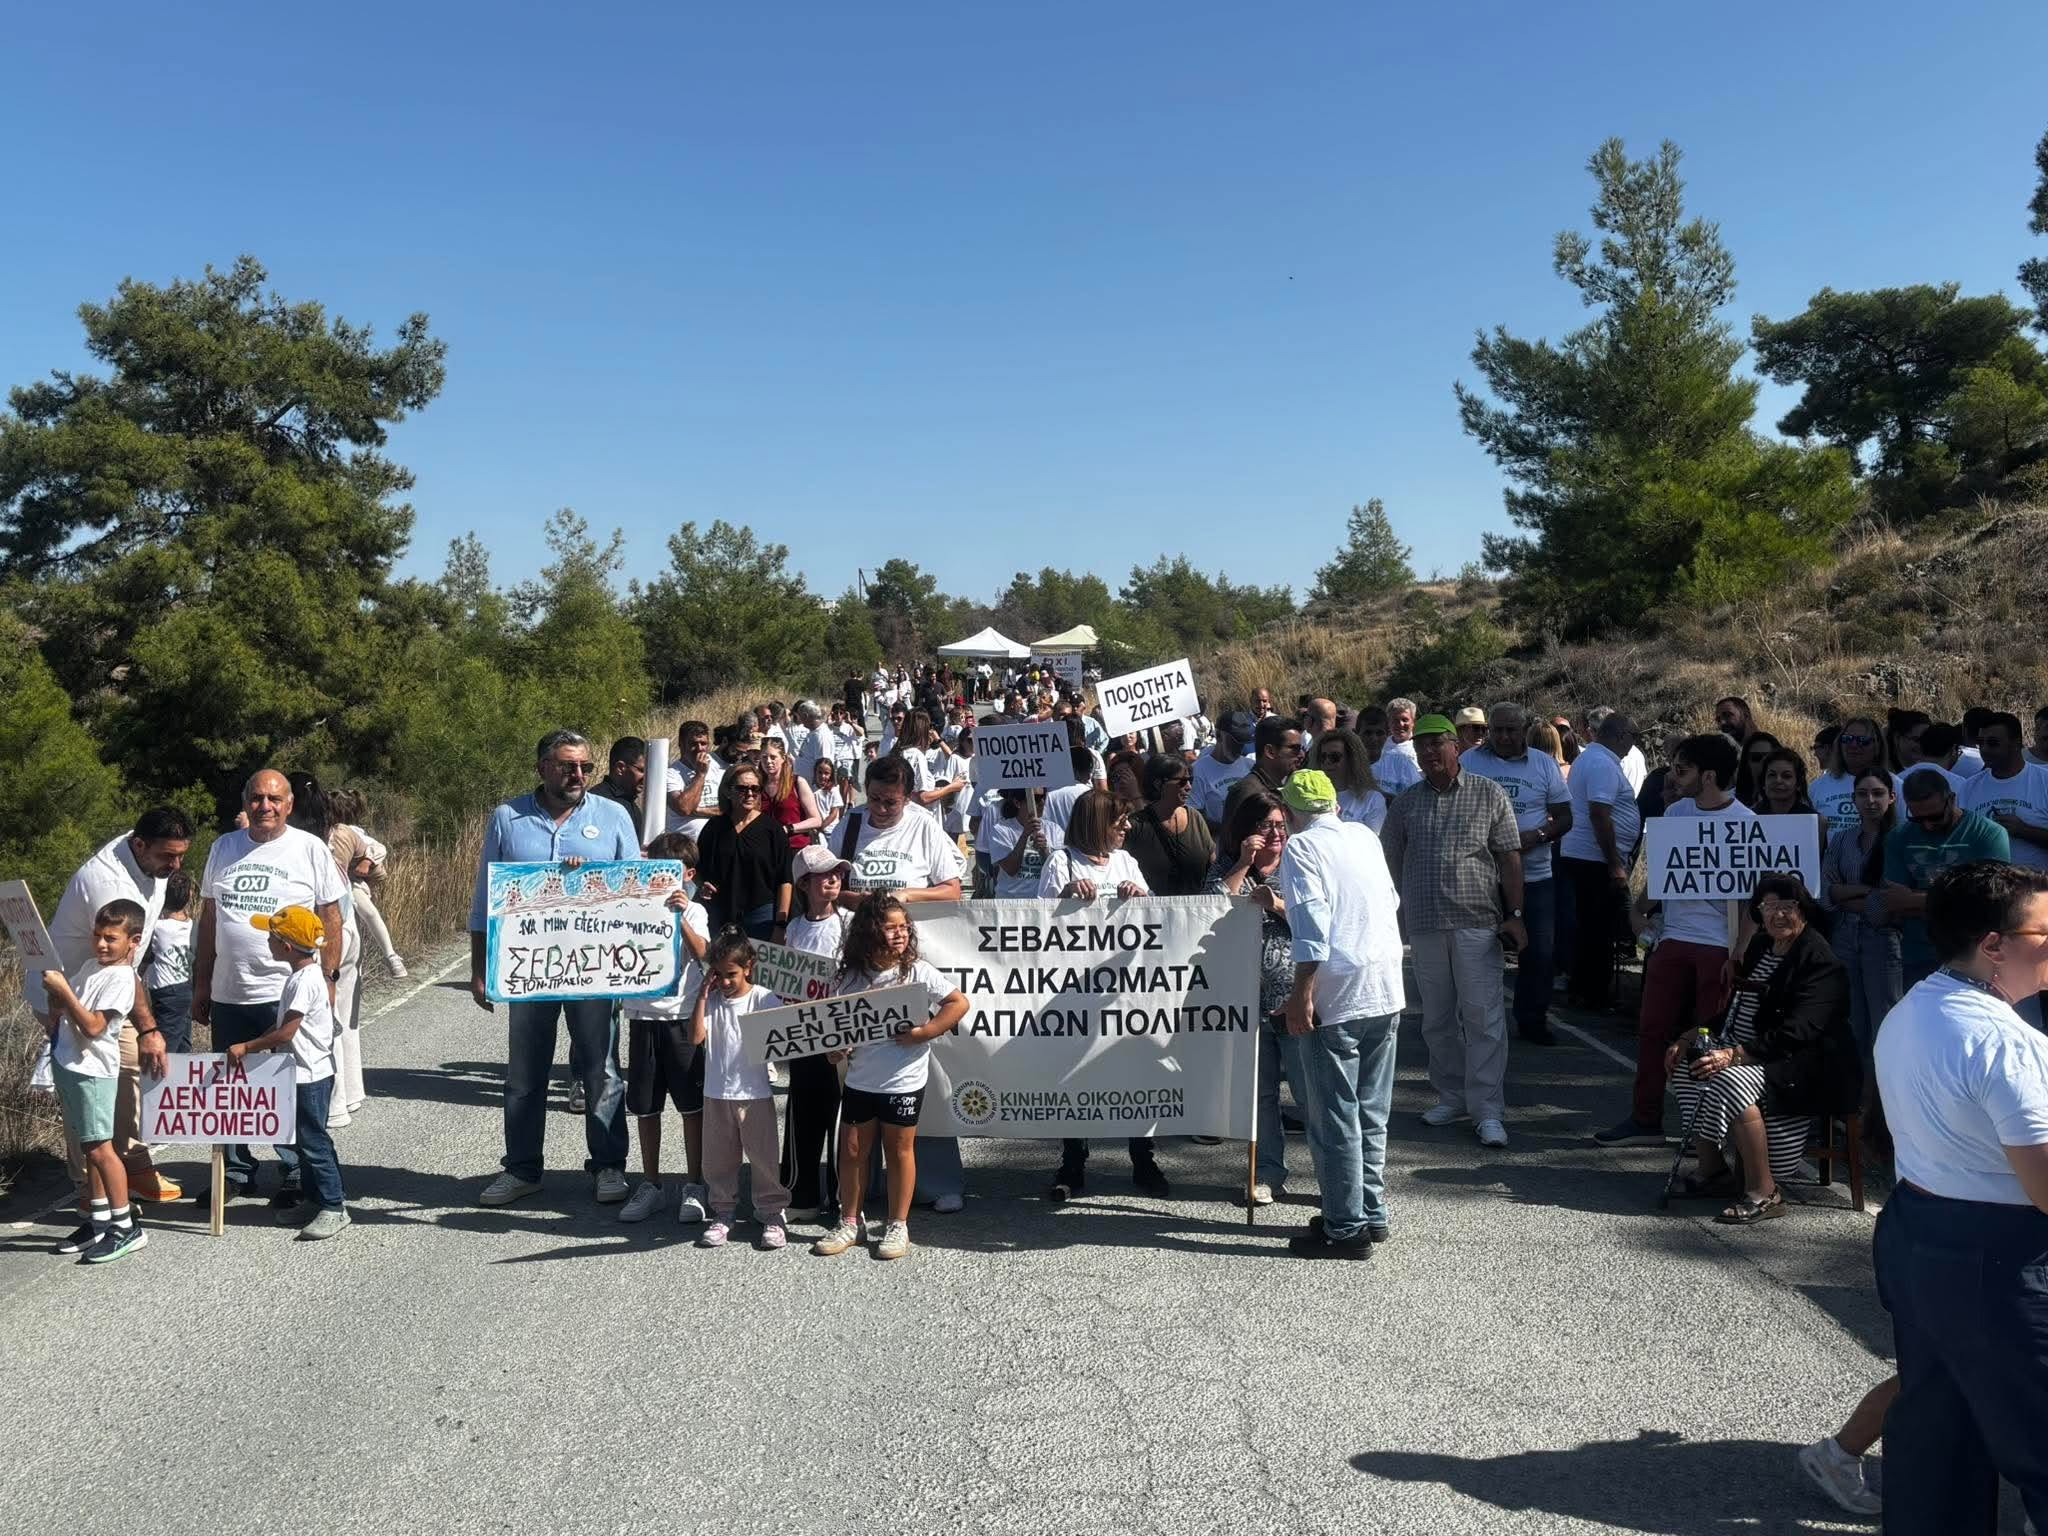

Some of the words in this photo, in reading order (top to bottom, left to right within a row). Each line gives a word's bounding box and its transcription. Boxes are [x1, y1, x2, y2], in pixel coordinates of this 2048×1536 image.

[1104, 671, 1187, 707] ΠΟΙΟΤΗΤΑ
[1128, 696, 1173, 722] ΖΩΗΣ
[978, 733, 1063, 756] ΠΟΙΟΤΗΤΑ
[1001, 758, 1046, 778] ΖΩΗΣ
[1699, 821, 1714, 844] Η
[1725, 821, 1766, 844] ΣΙΑ
[865, 861, 894, 875] ΟΧΙ
[1666, 846, 1720, 869] ΔΕΝ
[1730, 845, 1799, 868] ΕΙΝΑΙ
[236, 876, 267, 892] ΟΧΙ
[1663, 870, 1804, 894] ΛΑΤΟΜ
[240, 895, 278, 906] ΕΠΕΚΤΑΣΗ
[544, 917, 568, 932] ΜΗΝ
[978, 924, 1163, 952] ΣΕΒΑΣΜΟΣ
[508, 944, 662, 979] ΣΕΒΑΣΜΟΣ
[807, 978, 830, 1000] ΟΧΙ
[937, 967, 995, 994] ΤΑ
[1004, 965, 1209, 995] ΔΙΚΑΙΩΜΑΤΑ
[798, 1006, 816, 1023] Η
[827, 997, 873, 1018] ΣΙΑ
[969, 1010, 1088, 1037] ΑΠΛΩΝ
[1101, 1004, 1248, 1036] ΠΟΛΙΤΩΝ
[765, 1020, 824, 1045] ΔΕΝ
[834, 1005, 908, 1032] ΕΙΝΑΙ
[189, 1061, 203, 1084] Η
[212, 1060, 248, 1084] ΣΙΑ
[158, 1086, 206, 1110] ΔΕΝ
[215, 1086, 276, 1110] ΕΙΝΑΙ
[1001, 1091, 1074, 1107] ΚΙΝΗΜΑ
[1077, 1088, 1184, 1106] ΟΙΚΟΛΟΓΩΝ
[155, 1112, 279, 1136] ΛΑΤΟΜΕΙΟ
[1000, 1107, 1104, 1121] ΣΥΝΕΡΓΑΣΙΑ
[1109, 1104, 1184, 1120] ΠΟΛΙΤΩΝ
